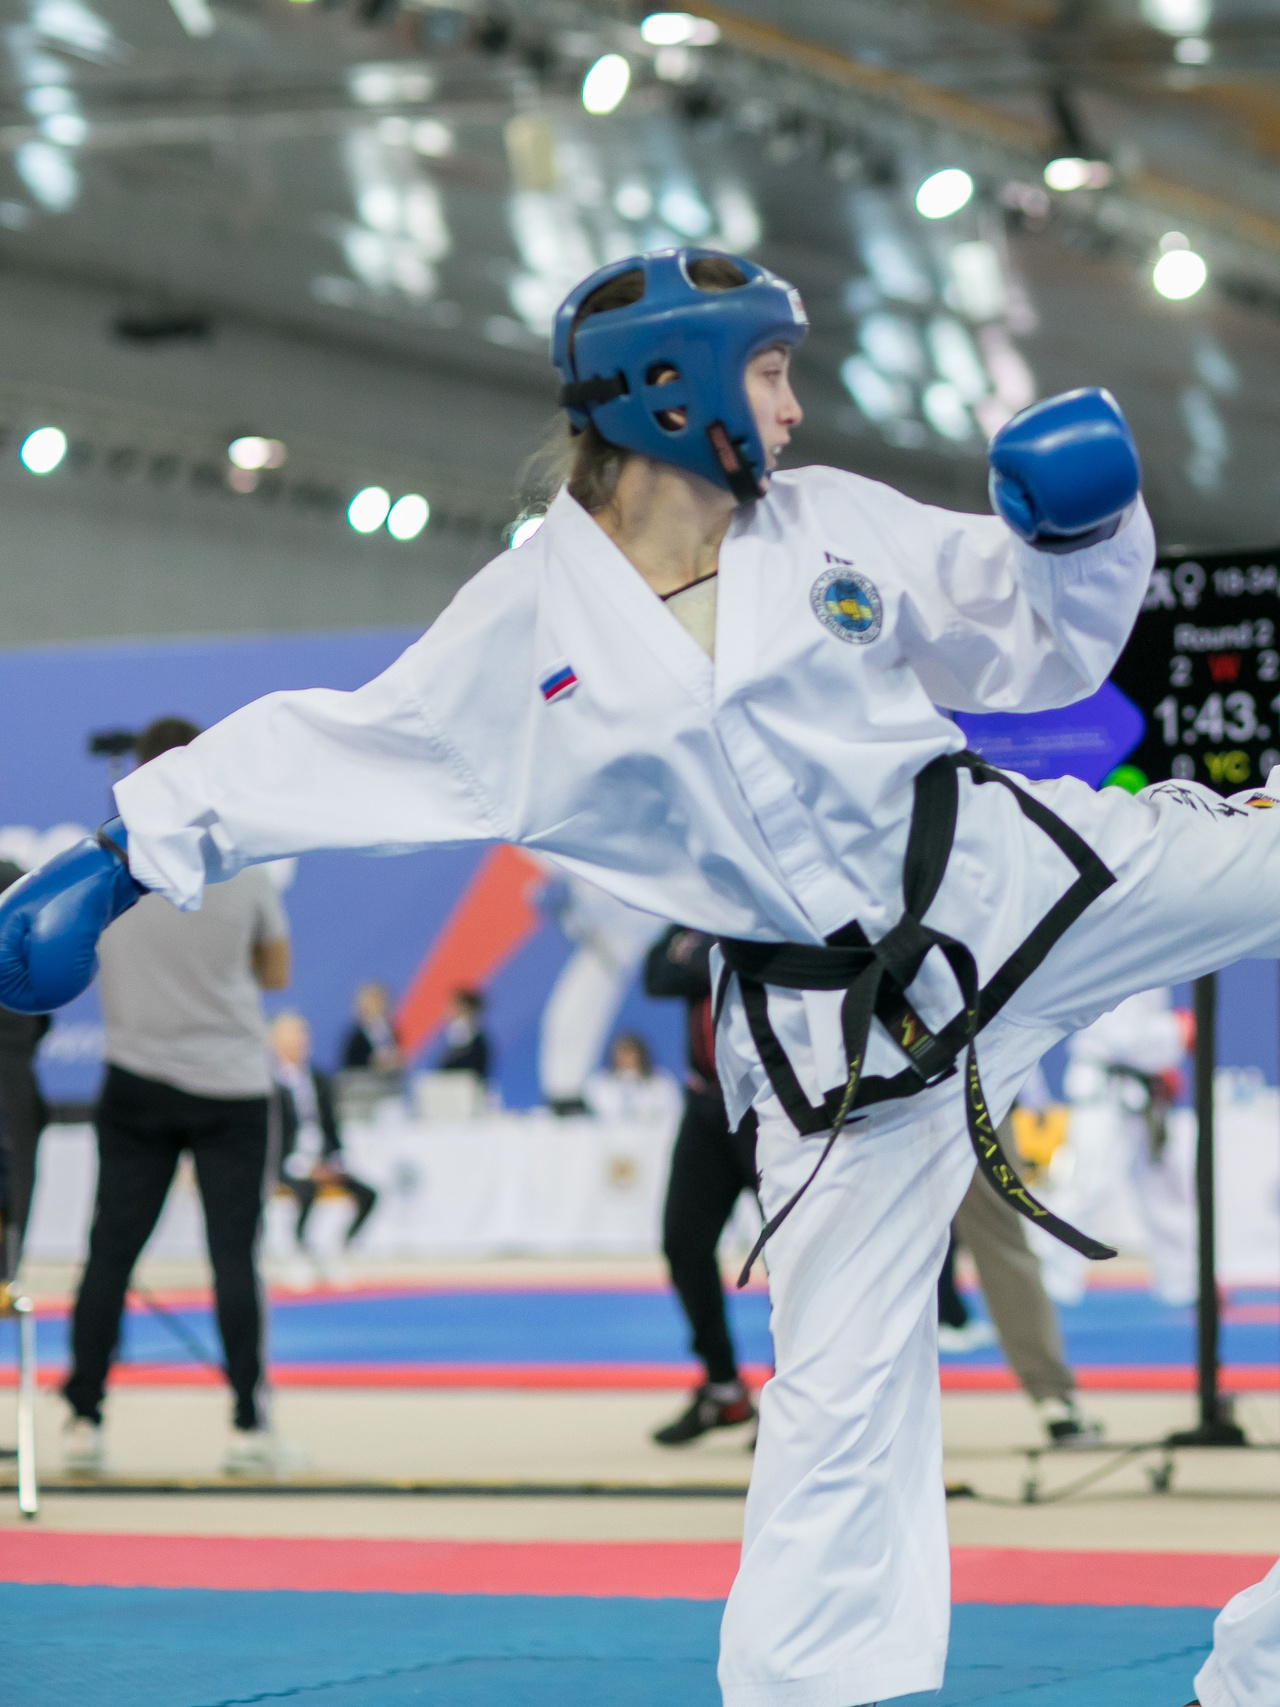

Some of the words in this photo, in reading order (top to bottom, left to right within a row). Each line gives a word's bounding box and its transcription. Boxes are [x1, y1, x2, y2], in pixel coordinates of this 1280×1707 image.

[1253, 618, 1274, 648] 2
[1169, 654, 1193, 687] 2
[1257, 649, 1280, 681] 2
